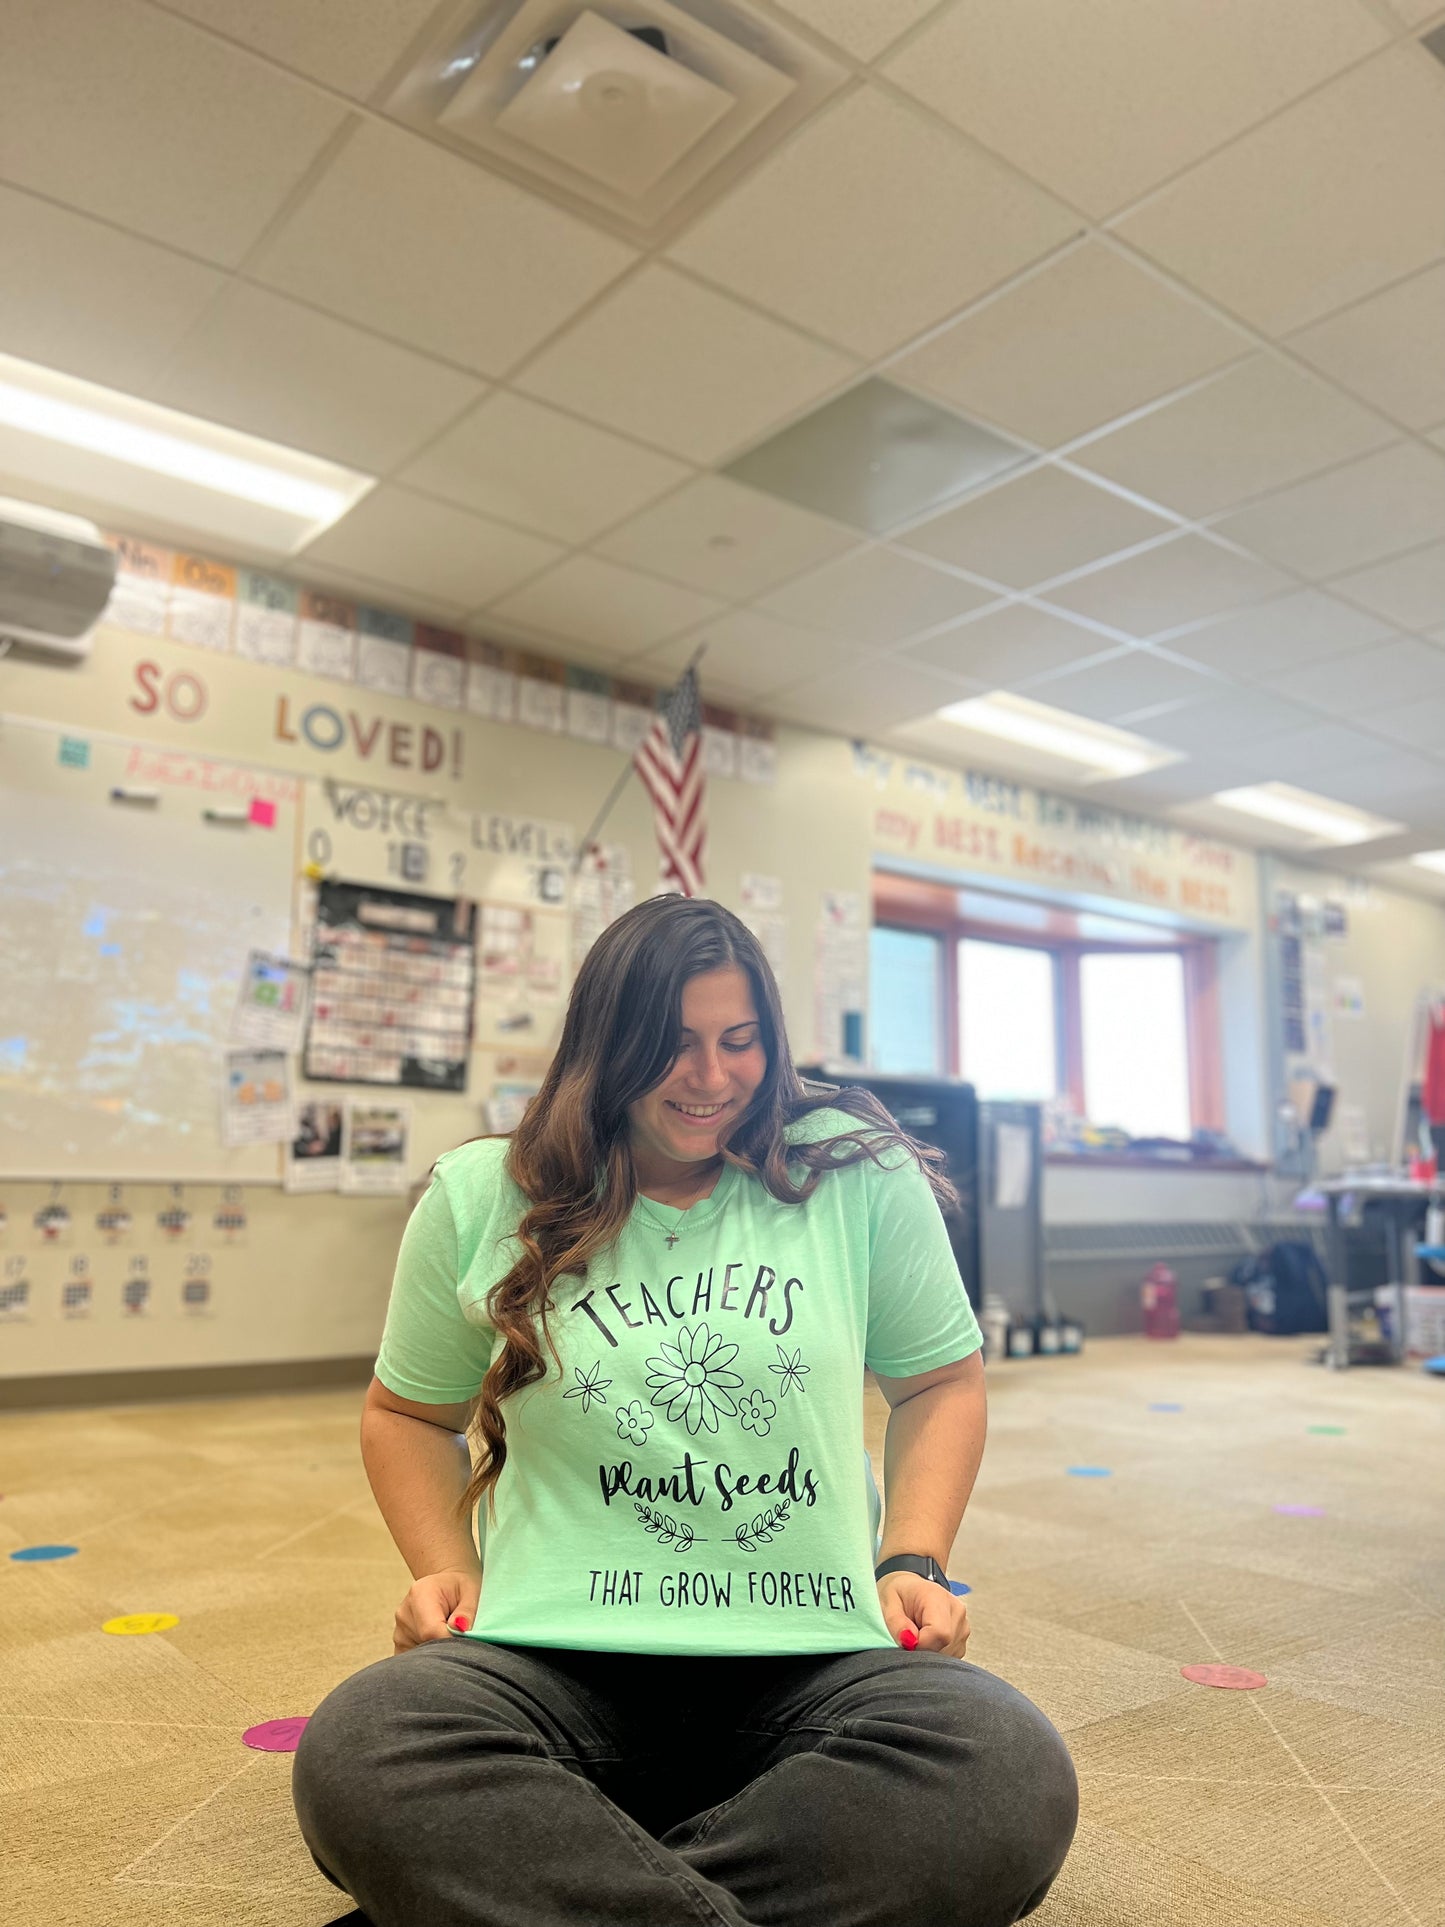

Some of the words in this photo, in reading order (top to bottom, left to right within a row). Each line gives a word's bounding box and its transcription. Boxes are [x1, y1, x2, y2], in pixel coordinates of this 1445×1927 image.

[130, 661, 207, 720] SO
[275, 697, 463, 780] LOVED!
[323, 778, 431, 841] VOICE
[571, 1262, 804, 1348] TEACHERS
[590, 1570, 643, 1606] THAT
[660, 1571, 731, 1608] GROW
[748, 1571, 855, 1612] FOREVER
